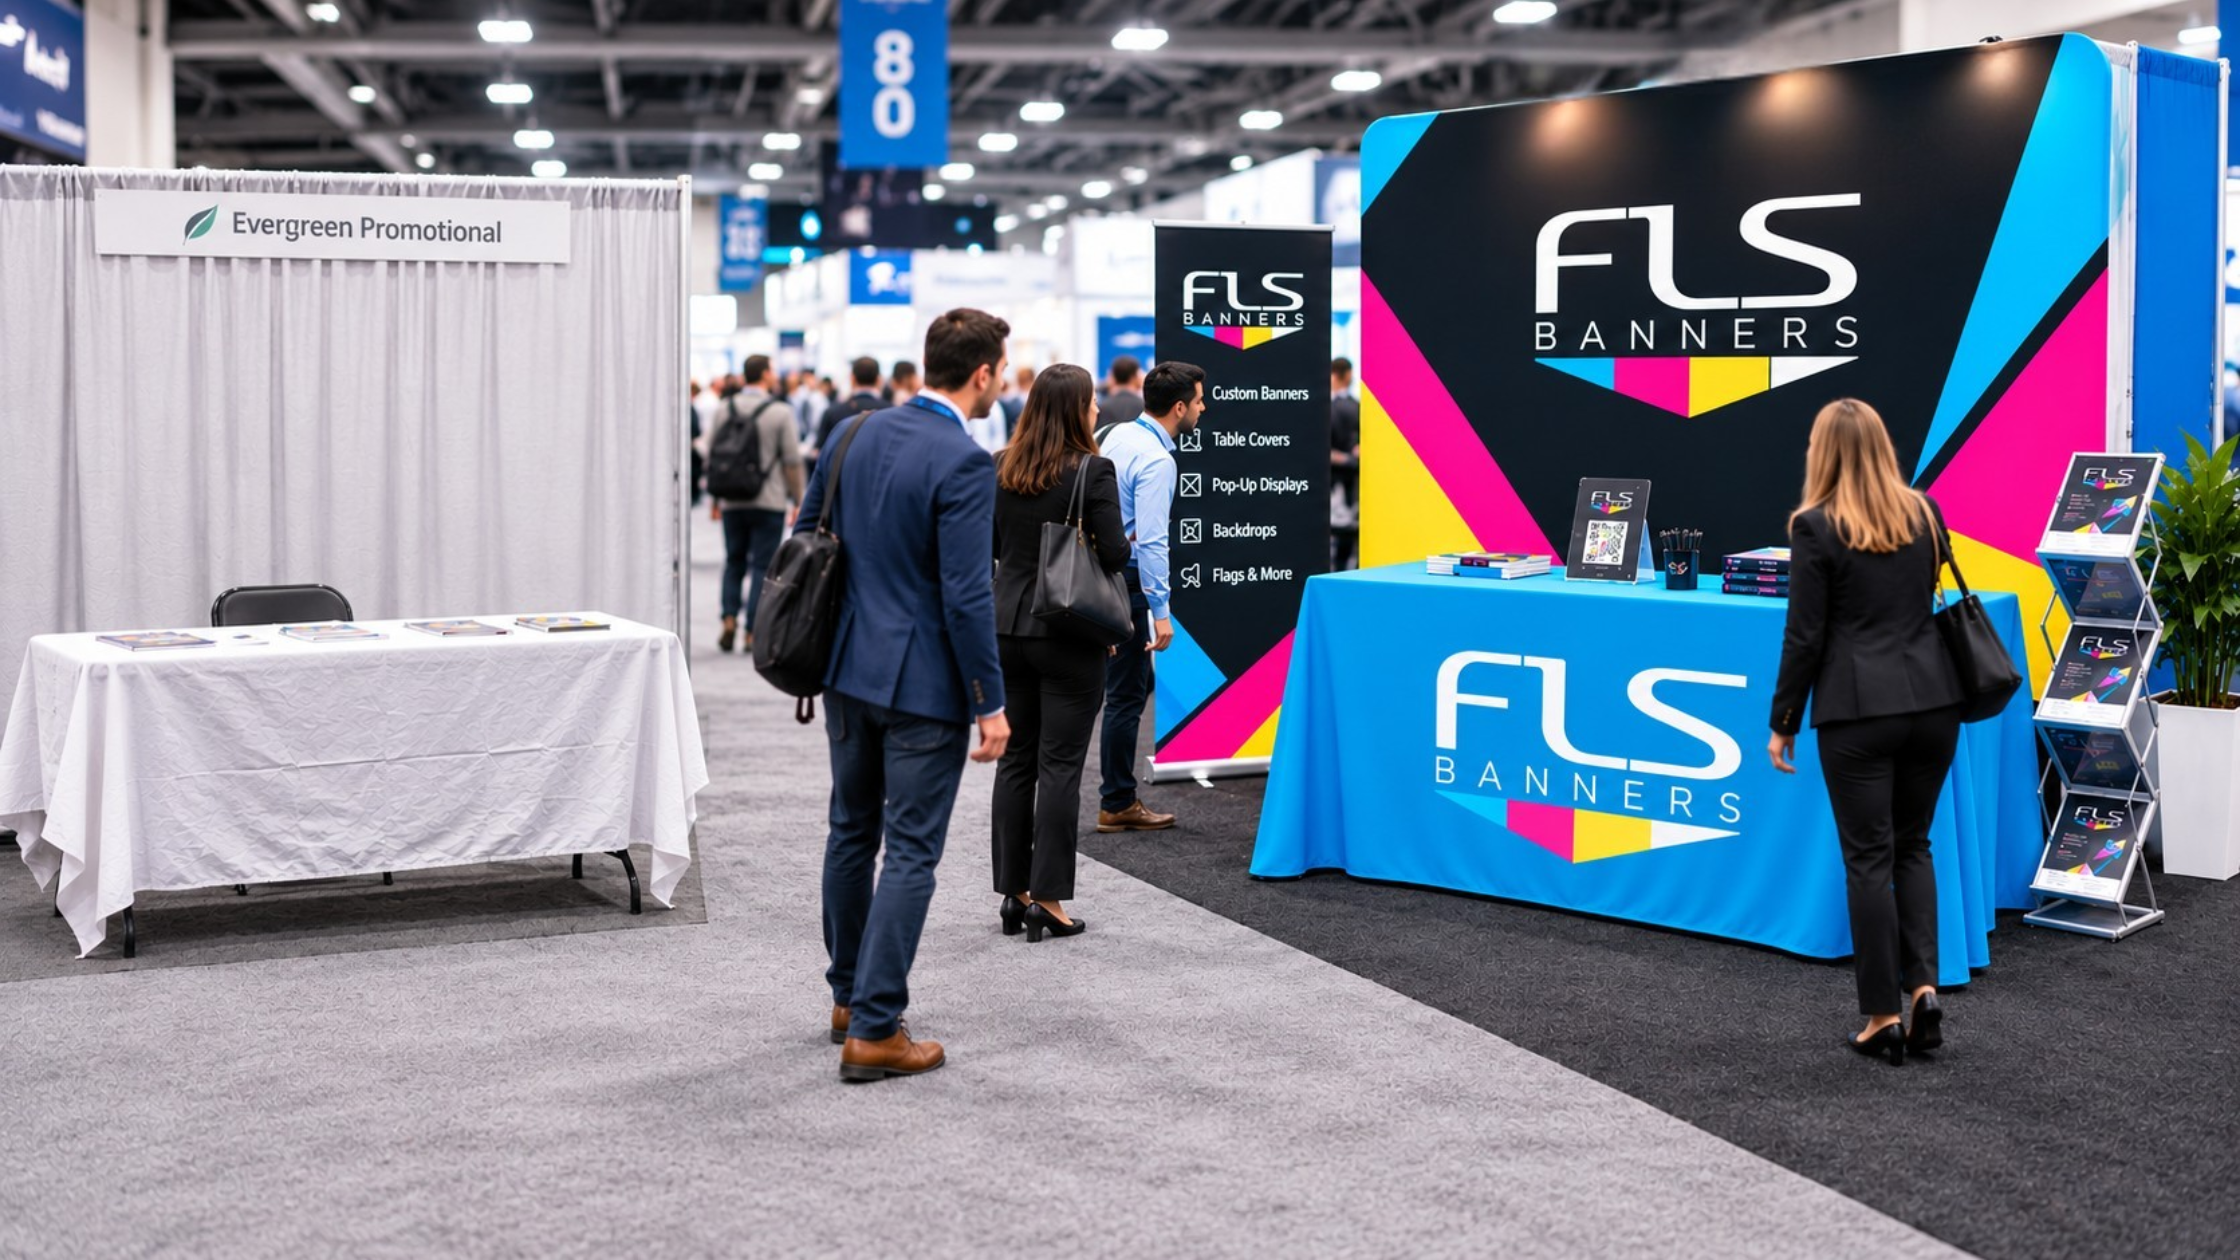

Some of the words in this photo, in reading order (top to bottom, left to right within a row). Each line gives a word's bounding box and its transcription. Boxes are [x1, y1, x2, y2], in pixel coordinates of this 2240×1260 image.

[232, 211, 353, 242] Evergreen
[361, 216, 502, 243] Promotional
[1535, 193, 1861, 313] FLS
[1183, 271, 1304, 312] FLS
[1183, 312, 1304, 326] BANNERS
[1535, 316, 1859, 351] BANNERS
[1212, 385, 1258, 401] Custom
[1261, 385, 1309, 401] Banners
[1212, 431, 1246, 446] Table
[1248, 432, 1290, 447] Covers
[2083, 467, 2137, 481] FLS
[1212, 477, 1257, 496] Pop-Up
[1260, 476, 1309, 495] Displays
[1590, 490, 1634, 503] FLS
[1213, 522, 1277, 540] Backdrops
[1212, 567, 1245, 586] Flags
[1247, 567, 1258, 582] &
[1261, 566, 1293, 581] More
[2080, 635, 2131, 650] FLS
[1436, 650, 1748, 780] FLS
[1435, 755, 1741, 824] BANNERS
[2074, 805, 2125, 821] FLS
